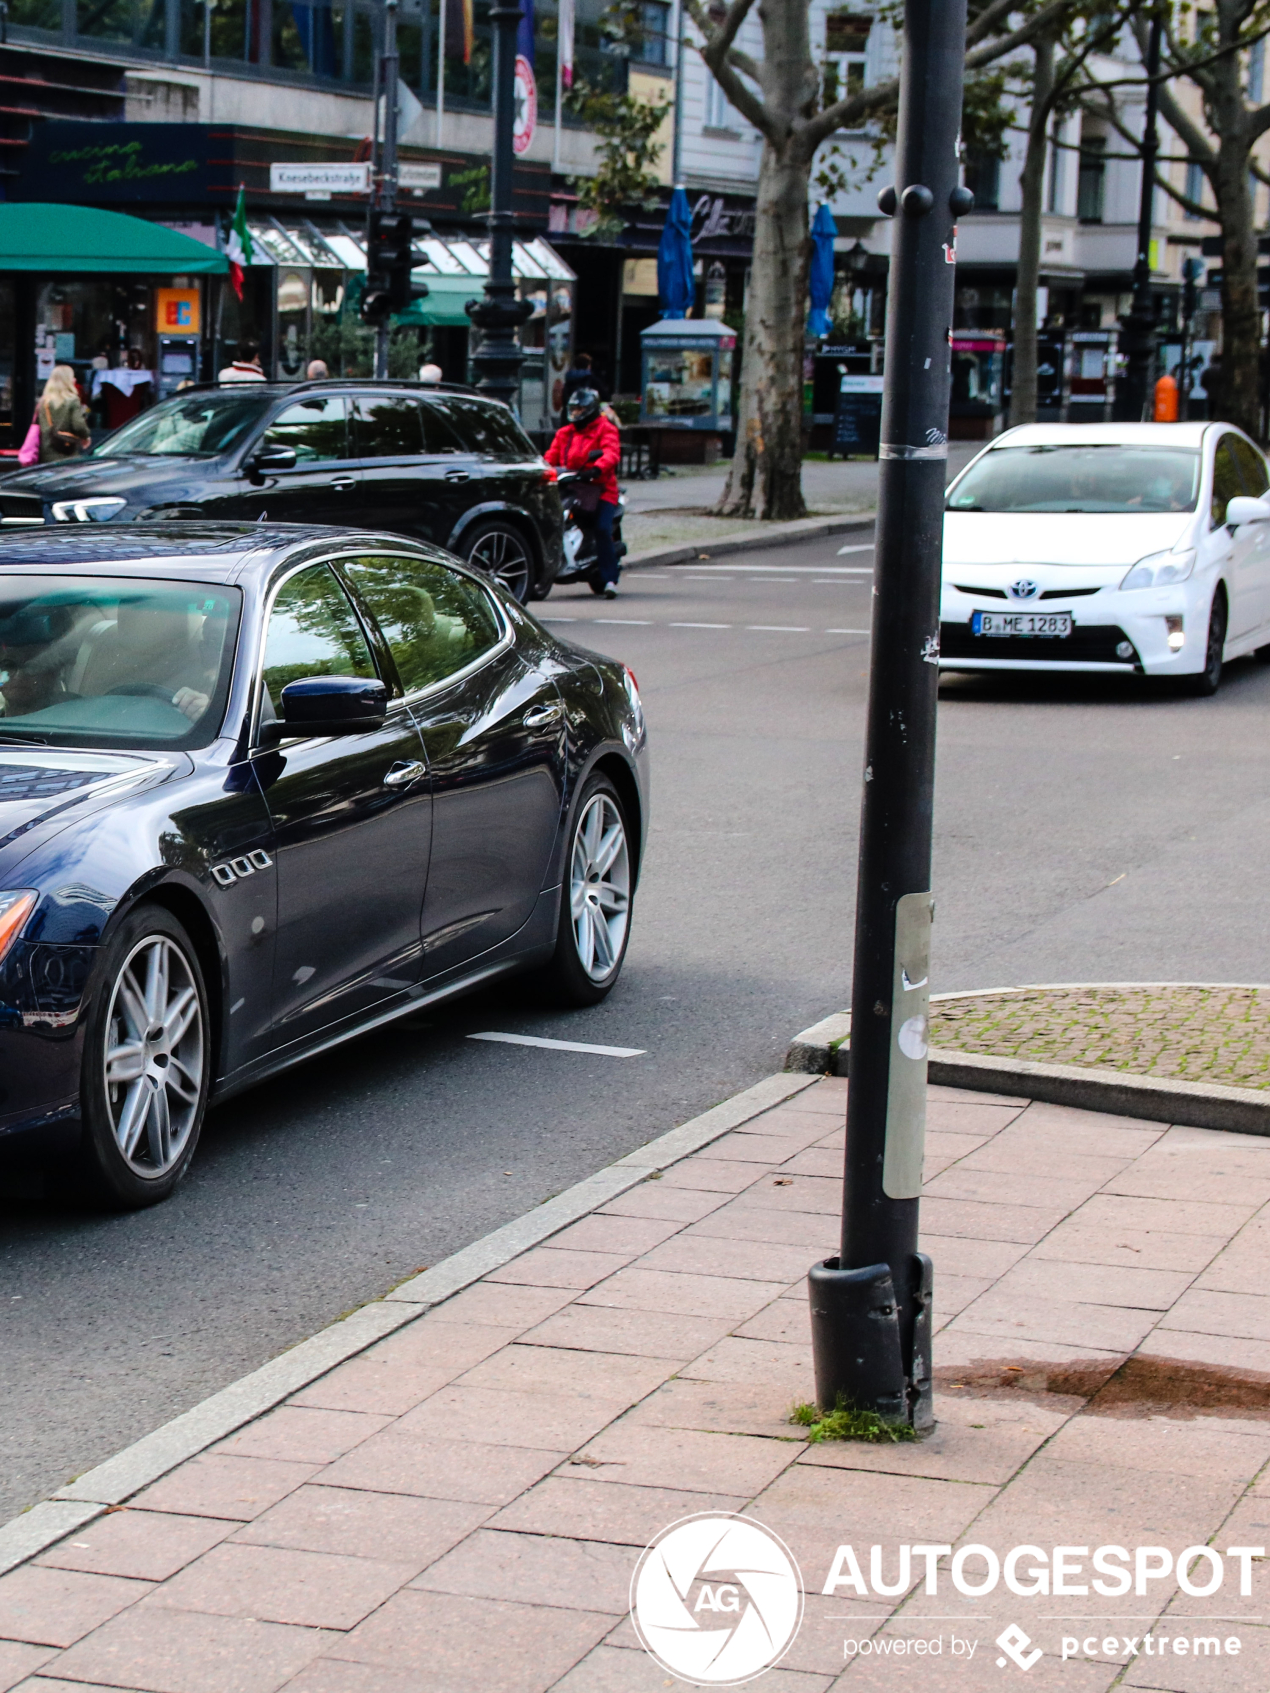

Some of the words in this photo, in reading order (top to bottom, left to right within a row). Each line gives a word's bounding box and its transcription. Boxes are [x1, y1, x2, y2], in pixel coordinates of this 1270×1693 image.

[48, 141, 142, 164] cucina
[83, 154, 198, 184] italiana
[165, 301, 191, 326] EC
[983, 617, 992, 631] B
[1003, 617, 1023, 632] ME
[1028, 617, 1069, 633] 1283
